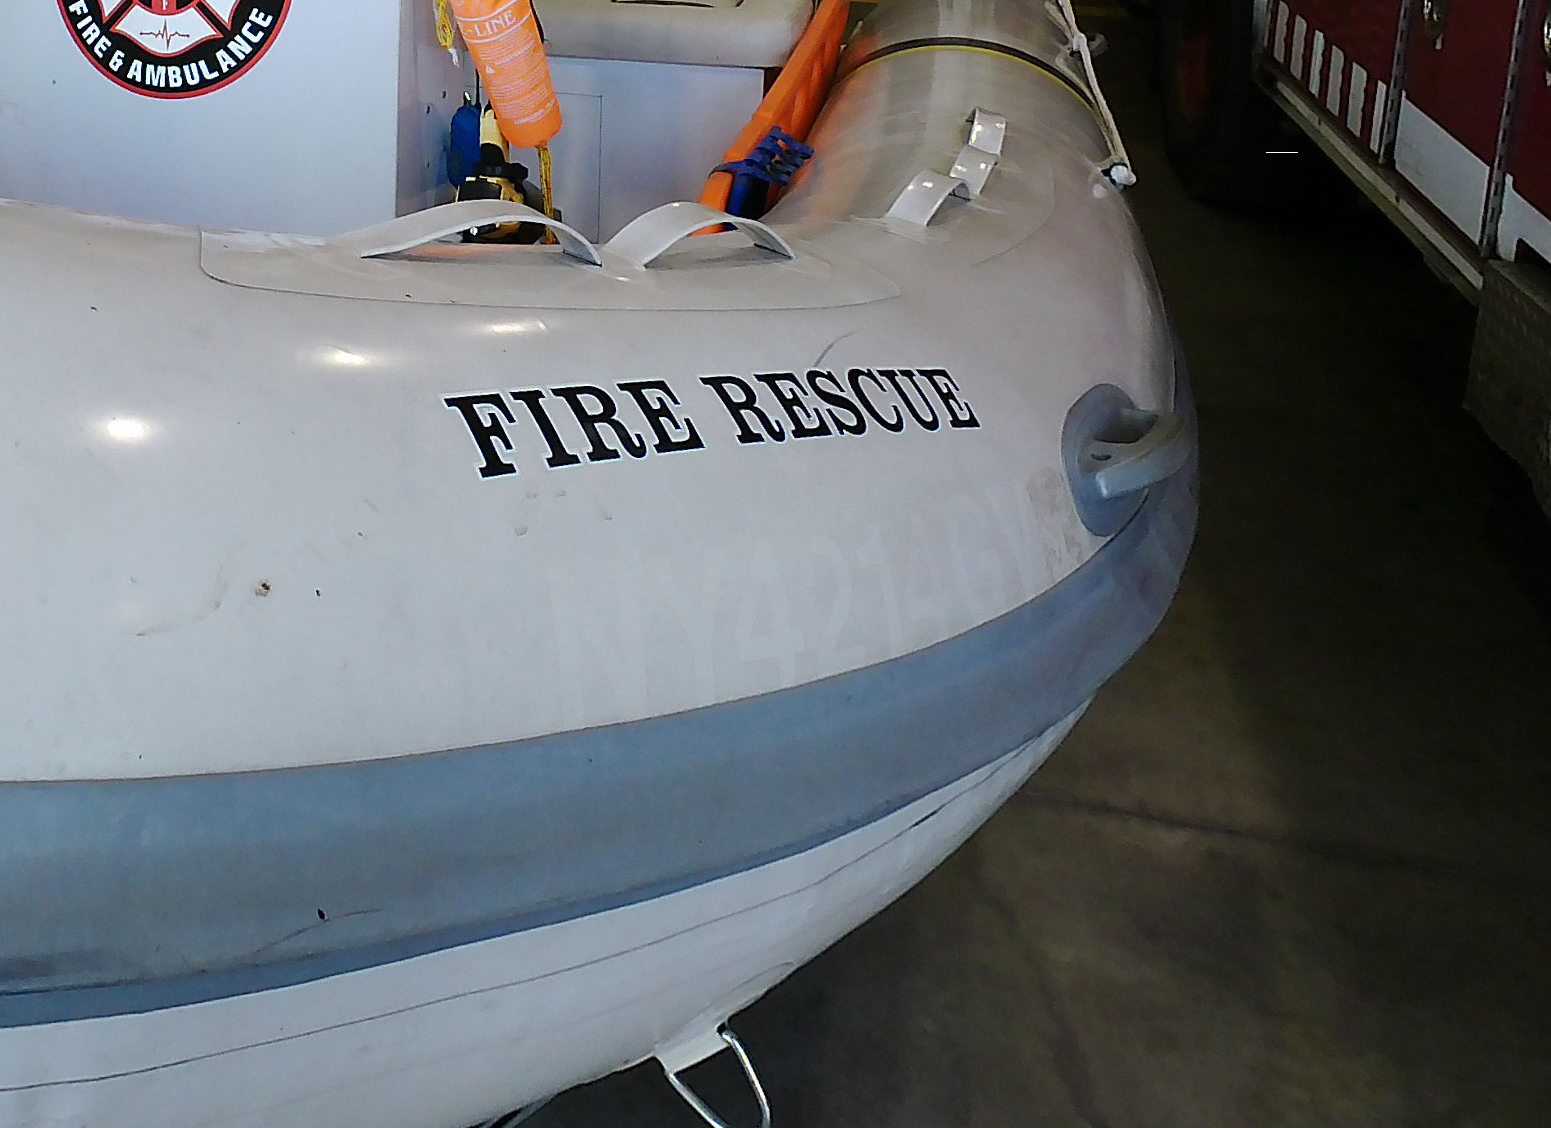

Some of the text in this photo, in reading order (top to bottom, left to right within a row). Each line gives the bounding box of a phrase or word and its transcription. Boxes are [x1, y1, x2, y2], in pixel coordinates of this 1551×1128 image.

[108, 49, 125, 72] &
[126, 7, 273, 88] AMBULANCE
[444, 368, 981, 479] FIRE RESCUE
